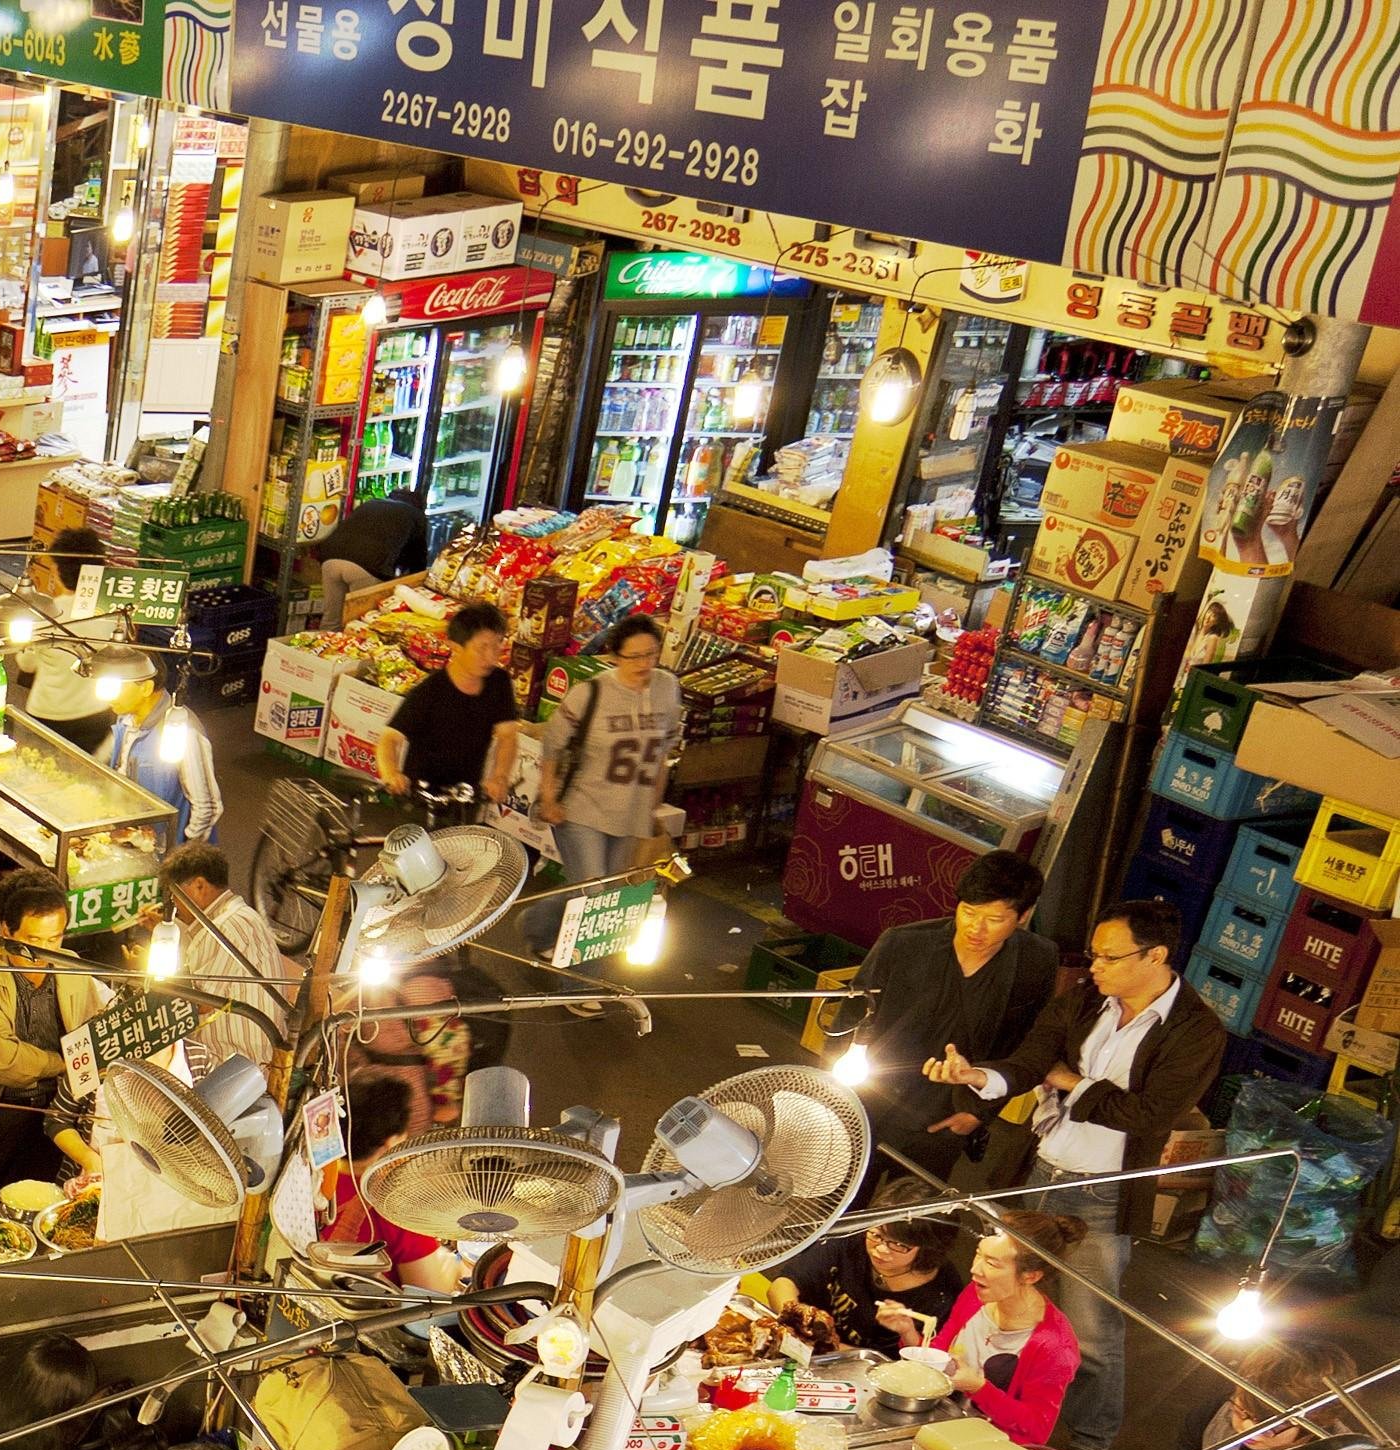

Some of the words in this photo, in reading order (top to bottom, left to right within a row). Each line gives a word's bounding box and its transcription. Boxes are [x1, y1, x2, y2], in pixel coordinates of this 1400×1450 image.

[260, 8, 363, 61] 선물용
[831, 1, 1059, 85] 일회용품
[382, 89, 511, 143] 2267-2928
[552, 117, 760, 187] 016-292-2928
[104, 575, 135, 599] 1호
[138, 577, 184, 604] 횟집
[288, 705, 319, 729] 양파링
[606, 738, 661, 786] 65
[1323, 855, 1367, 881] 서울탁주
[1303, 935, 1343, 964] HITE
[98, 1000, 194, 1061] 경태네집
[1276, 1007, 1316, 1037] HITE
[72, 1052, 90, 1071] 66
